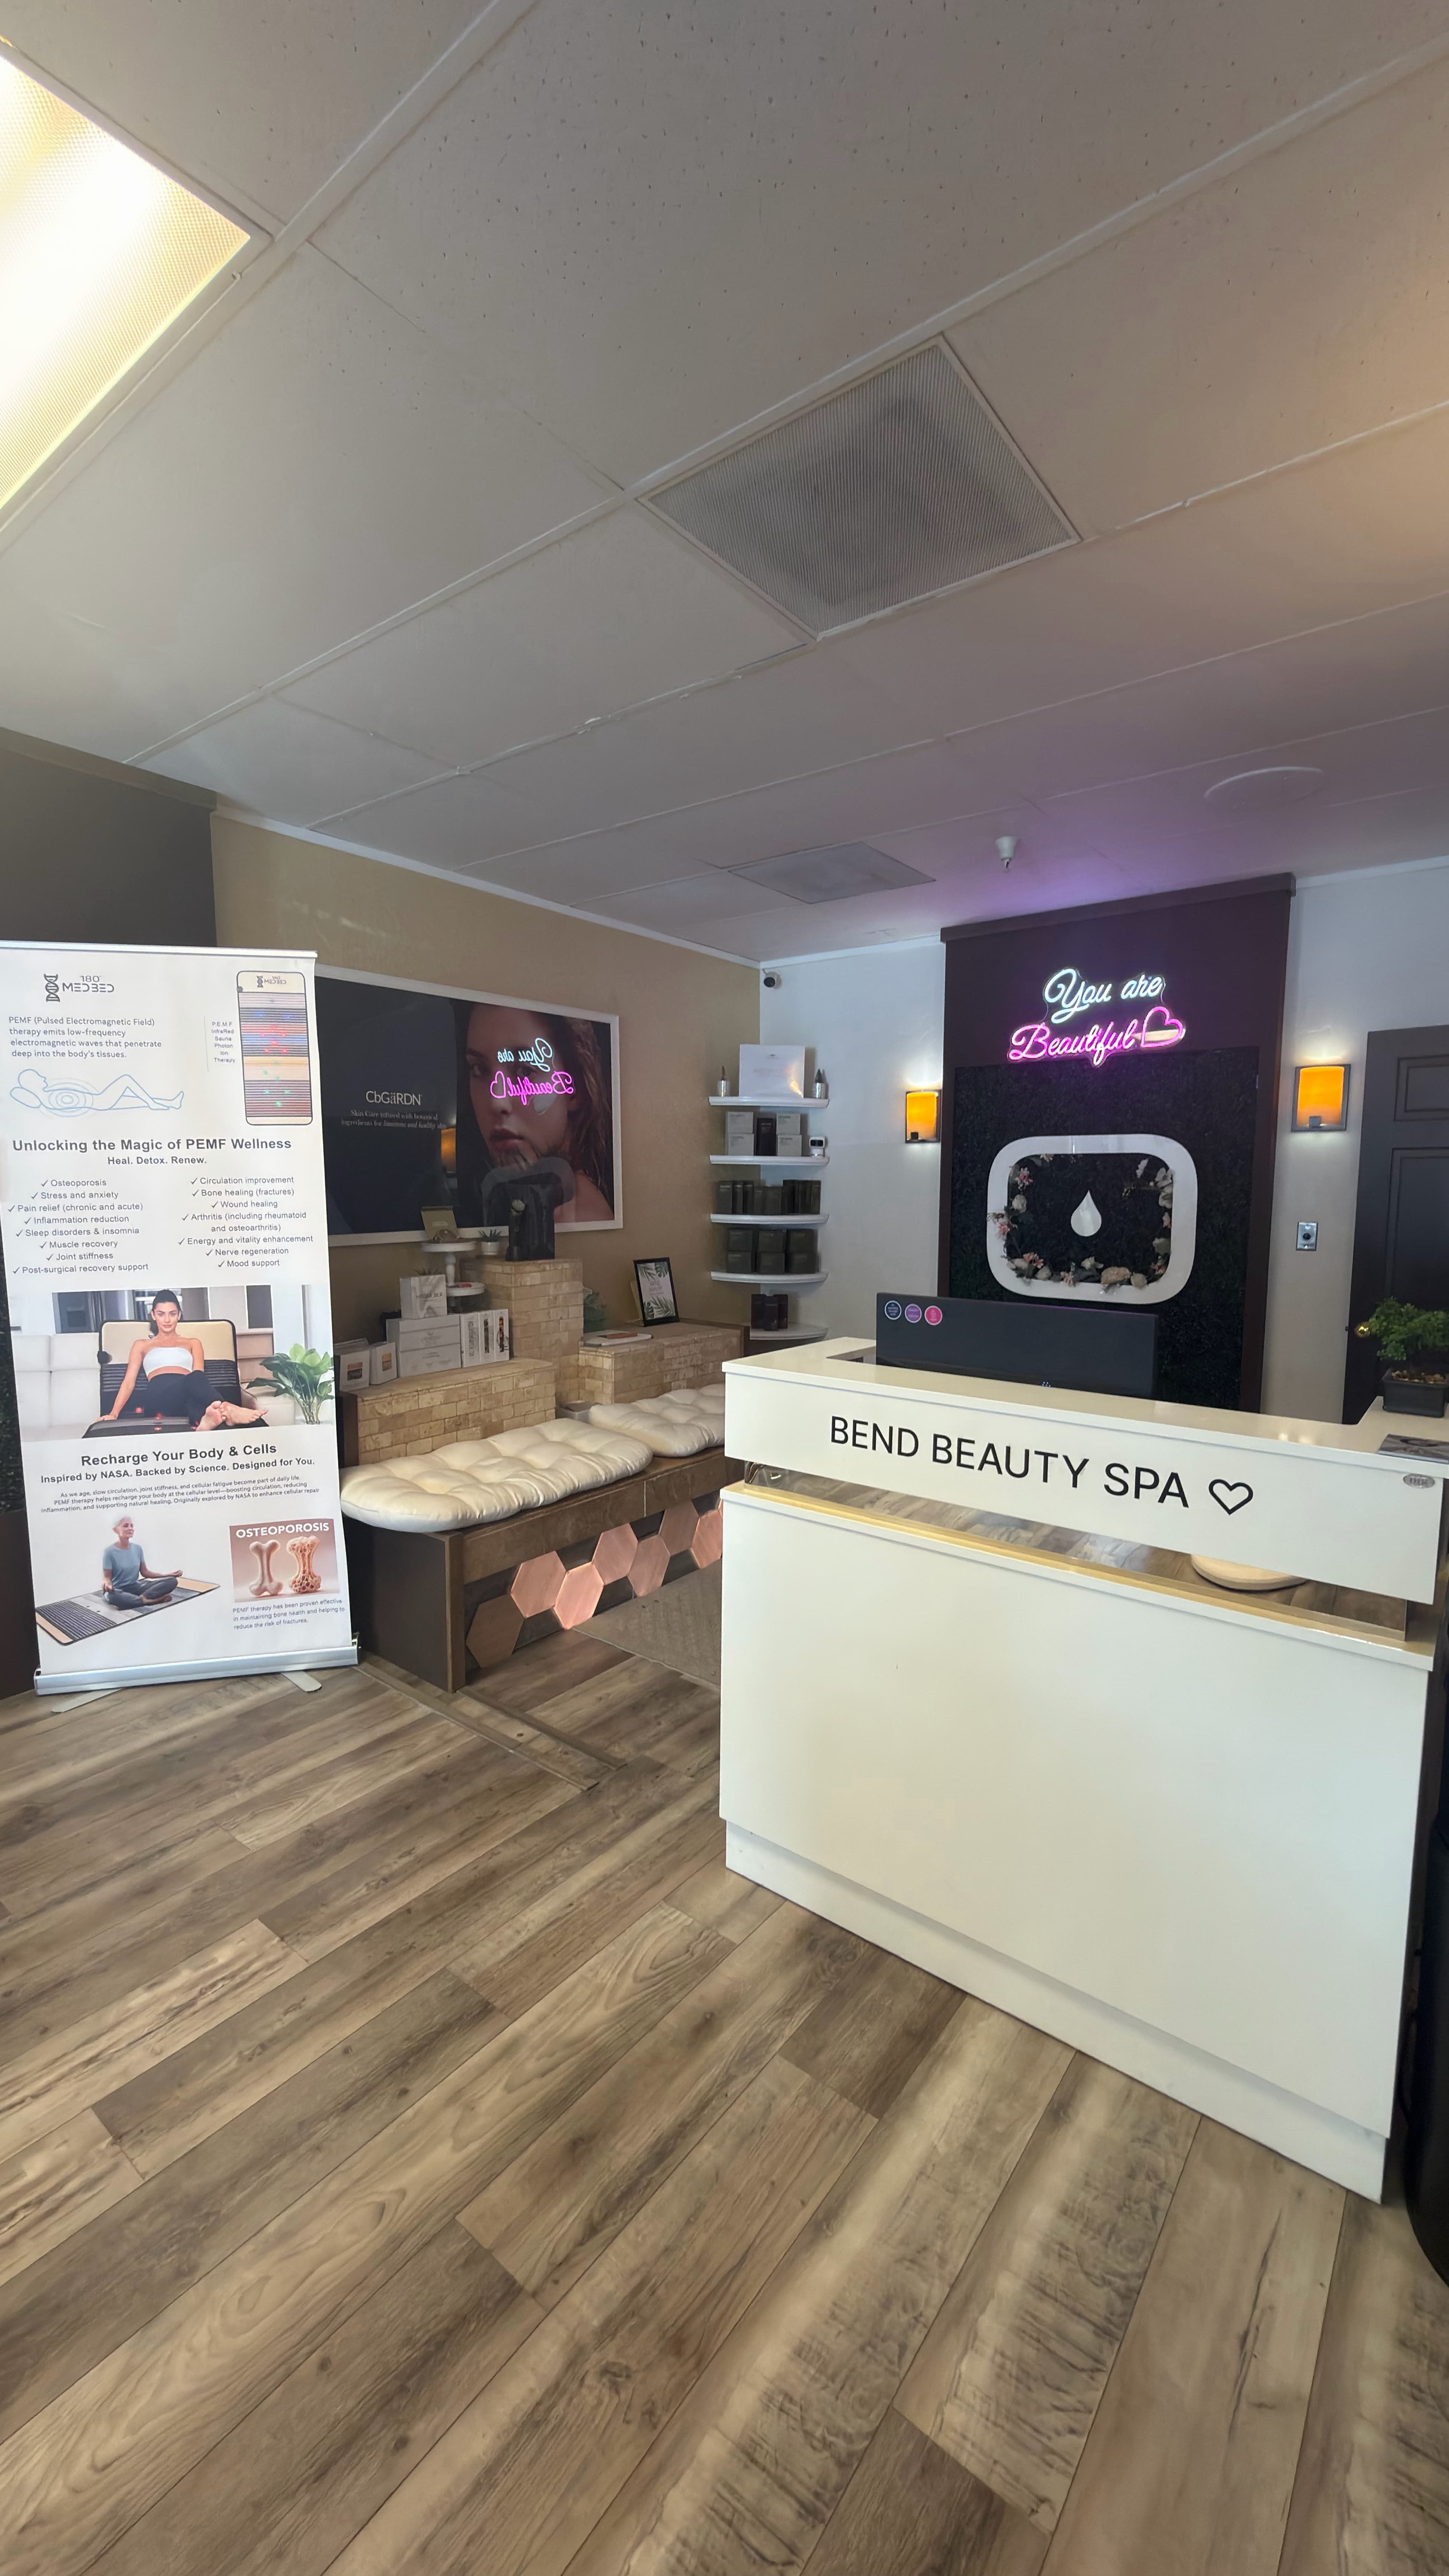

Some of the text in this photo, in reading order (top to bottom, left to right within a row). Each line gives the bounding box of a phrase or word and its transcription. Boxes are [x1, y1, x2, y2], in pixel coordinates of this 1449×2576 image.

[62, 983, 114, 992] MEDBED
[1044, 968, 1163, 1023] You are
[66, 1017, 131, 1026] Electromagnetic
[9, 1028, 41, 1037] therapy
[68, 1028, 126, 1037] low-frequency
[11, 1039, 76, 1047] electromagnetic
[1008, 1019, 1138, 1065] Beautiful
[12, 1050, 32, 1058] deep
[68, 1050, 94, 1059] body's
[13, 1138, 291, 1153] Unlocking the Magic of PEMF Wellness
[63, 1204, 96, 1212] (chronic
[22, 1266, 76, 1274] Post-surgical
[81, 1444, 276, 1466] Recharge Your Body & Cells
[831, 1415, 1189, 1508] BEND BEAUTY SPA
[41, 1473, 82, 1483] Inspired
[86, 1473, 97, 1481] by
[101, 1470, 132, 1478] NASA.
[136, 1467, 171, 1476] Backed
[174, 1467, 186, 1475] by
[232, 1459, 277, 1470] Designed
[236, 1523, 329, 1538] OSTEOPOROSIS
